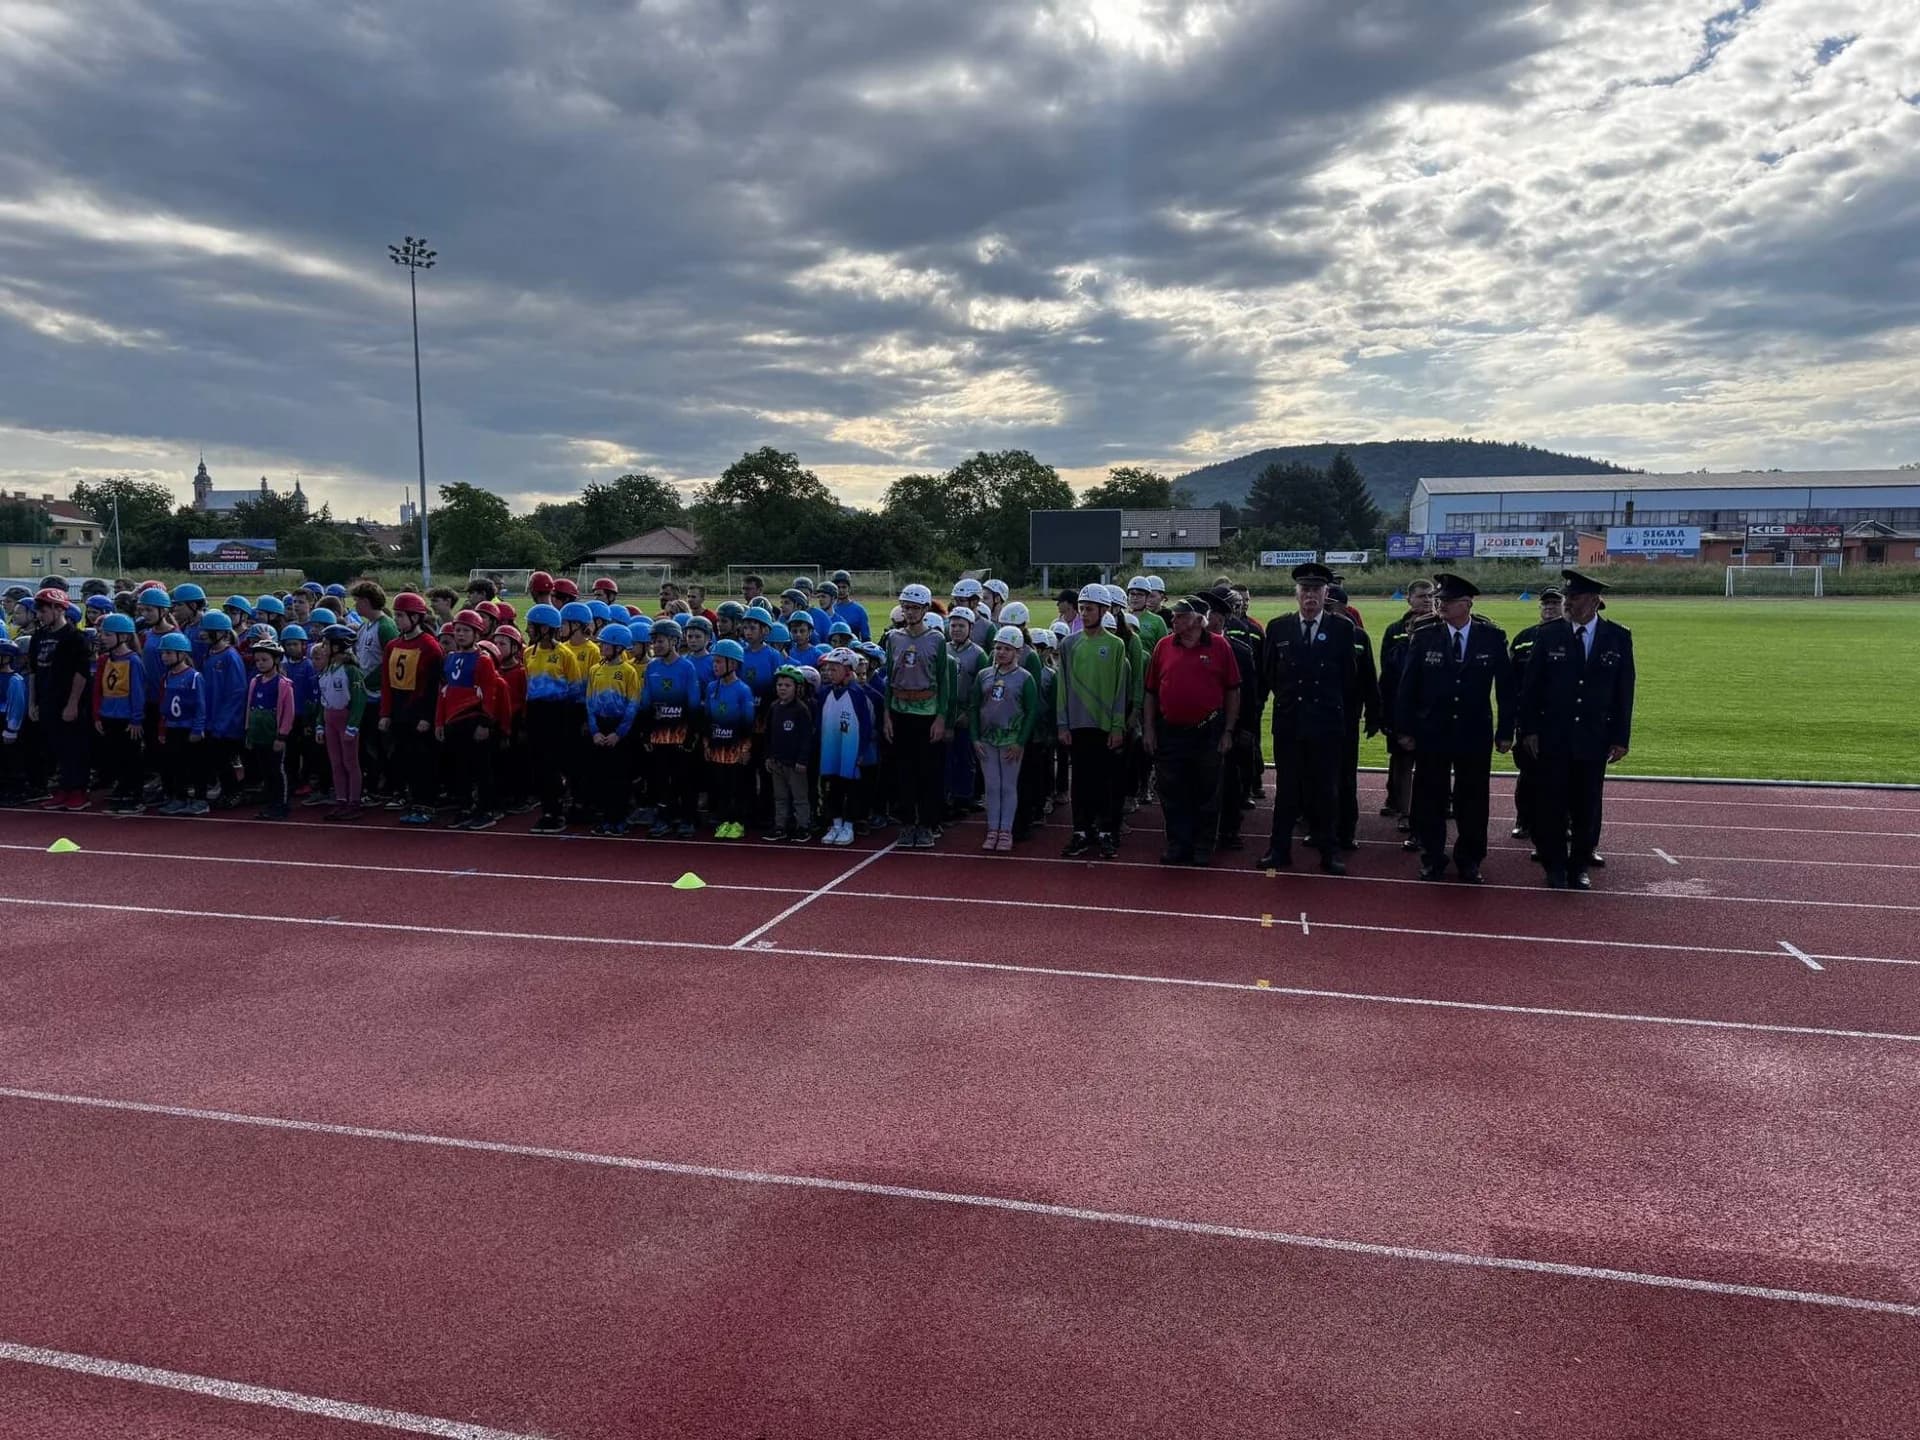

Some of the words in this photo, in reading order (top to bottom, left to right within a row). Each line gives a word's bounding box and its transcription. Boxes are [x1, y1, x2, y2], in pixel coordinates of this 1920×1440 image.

[1642, 529, 1686, 538] SIGMA
[1748, 526, 1841, 534] KIGMAX
[1483, 537, 1544, 547] IZOBETON
[1642, 539, 1685, 547] PUMPY
[396, 654, 407, 680] 5
[107, 669, 118, 690] 6
[171, 695, 181, 717] 6
